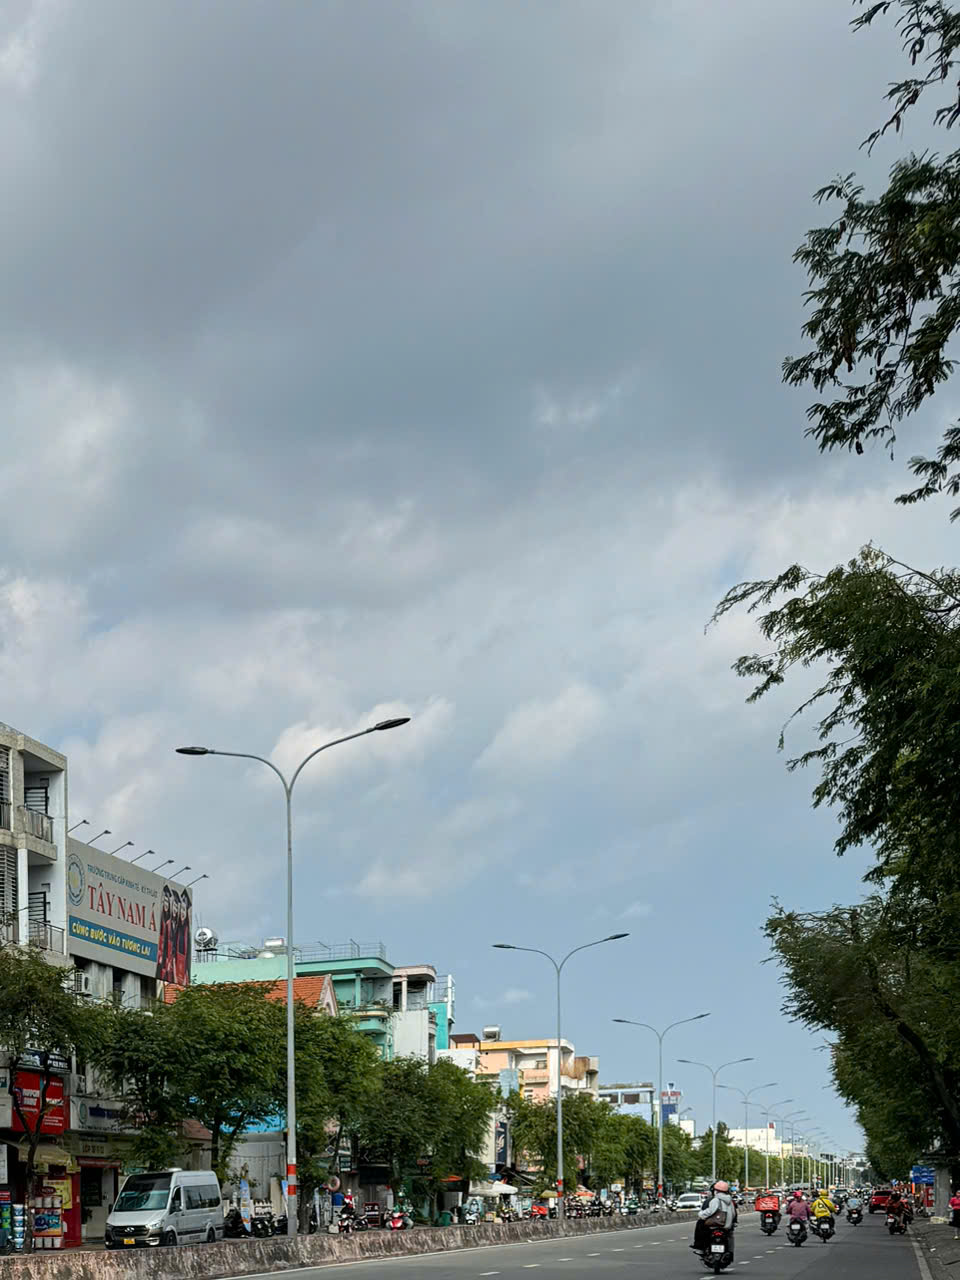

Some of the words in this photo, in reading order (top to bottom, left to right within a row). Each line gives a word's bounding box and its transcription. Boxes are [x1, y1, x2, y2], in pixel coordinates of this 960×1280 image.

[88, 882, 115, 917] TÂY
[117, 896, 146, 928] NAM
[148, 902, 157, 931] Á
[72, 921, 89, 937] CÙNG
[90, 926, 107, 942] BƯỚC
[108, 931, 121, 947] VÀO
[122, 938, 140, 953] TƯƠNG
[141, 944, 152, 956] LAI
